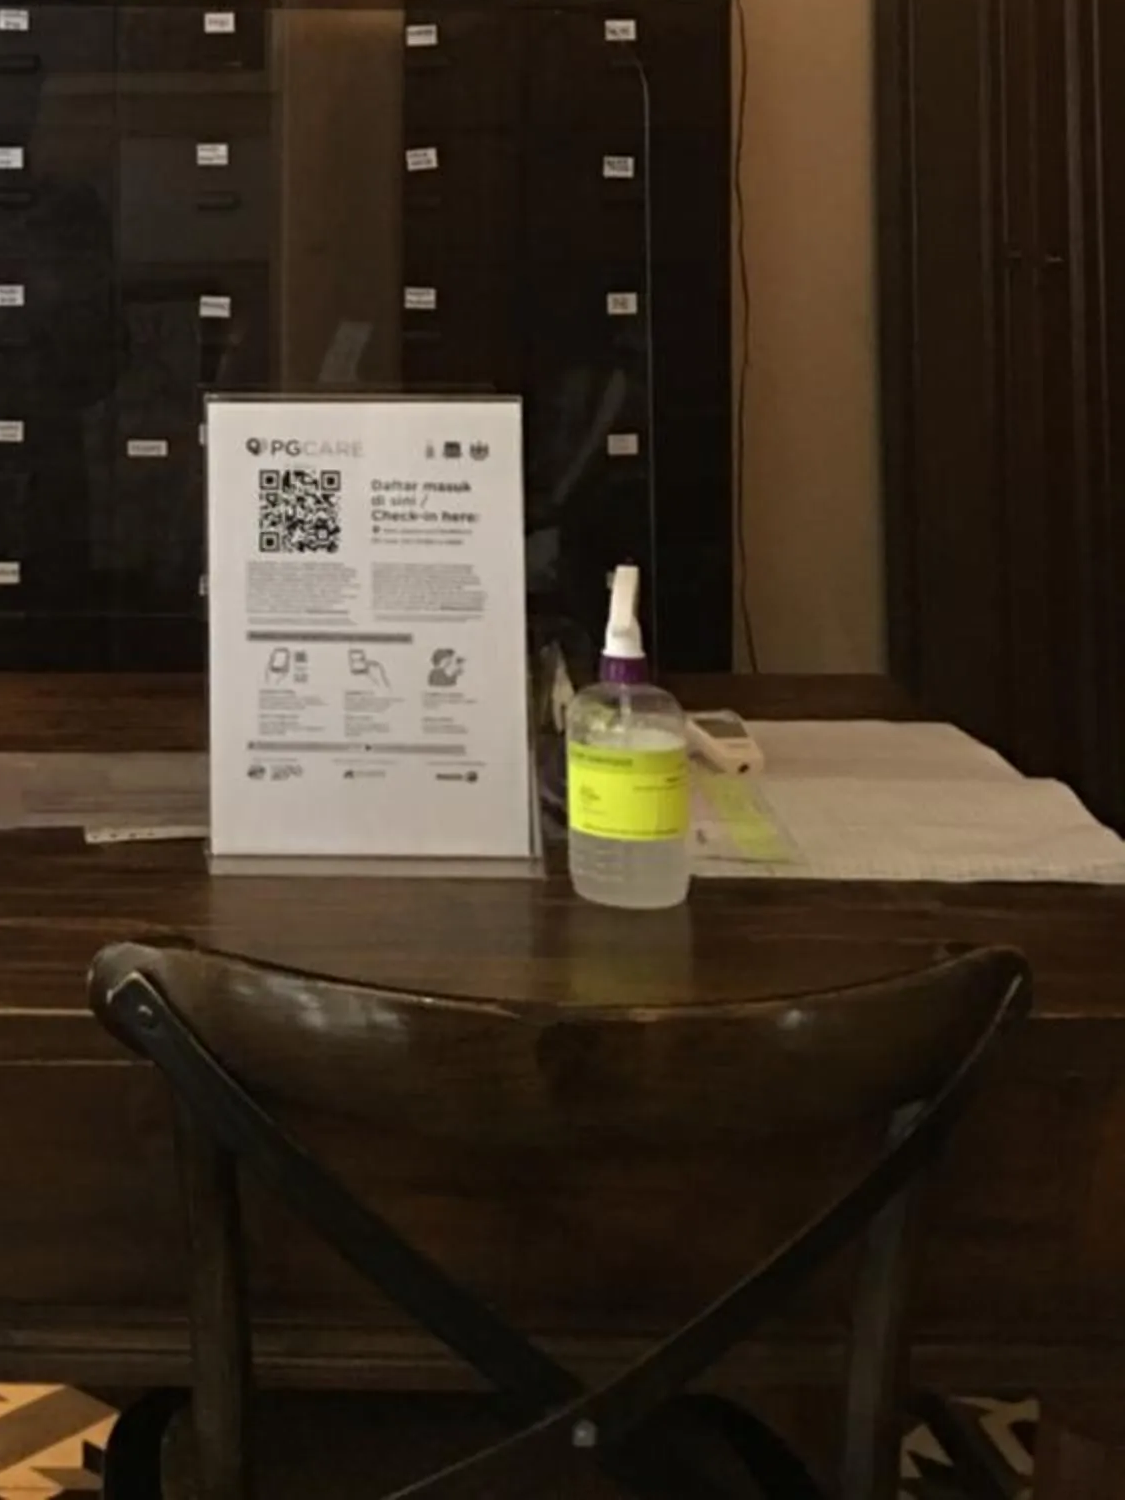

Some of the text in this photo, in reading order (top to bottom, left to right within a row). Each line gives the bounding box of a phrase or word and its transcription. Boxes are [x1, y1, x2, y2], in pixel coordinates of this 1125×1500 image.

[371, 479, 471, 492] Daftar masuk
[371, 509, 438, 523] Check-in
